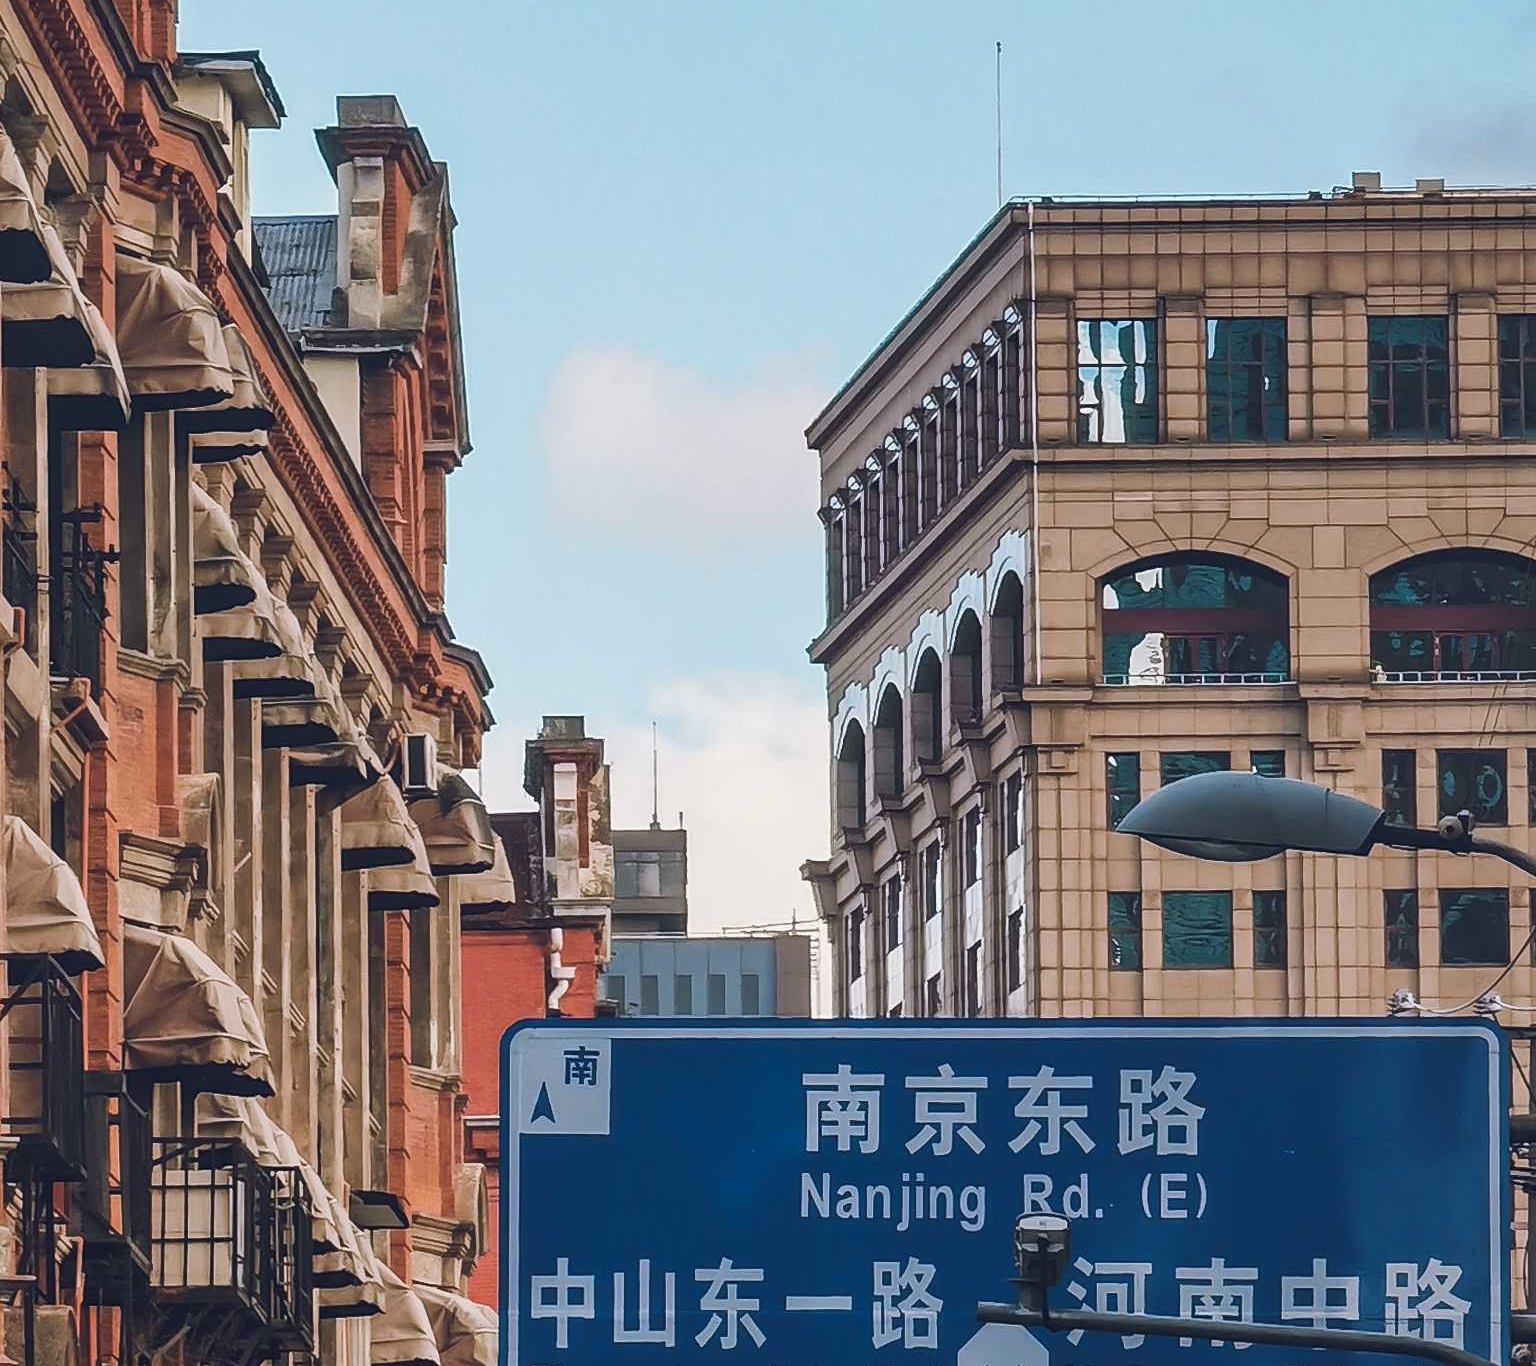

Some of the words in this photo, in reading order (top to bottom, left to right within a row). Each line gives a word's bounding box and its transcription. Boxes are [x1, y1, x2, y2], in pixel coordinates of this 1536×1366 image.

[563, 1045, 599, 1086] 南
[801, 1063, 1207, 1157] 南京东路
[799, 1172, 987, 1232] Nanjing
[1021, 1173, 1105, 1219] Rd.
[1140, 1172, 1208, 1220] (E)
[529, 1256, 945, 1351] 中山东一路
[1065, 1255, 1473, 1353] 河南中路
